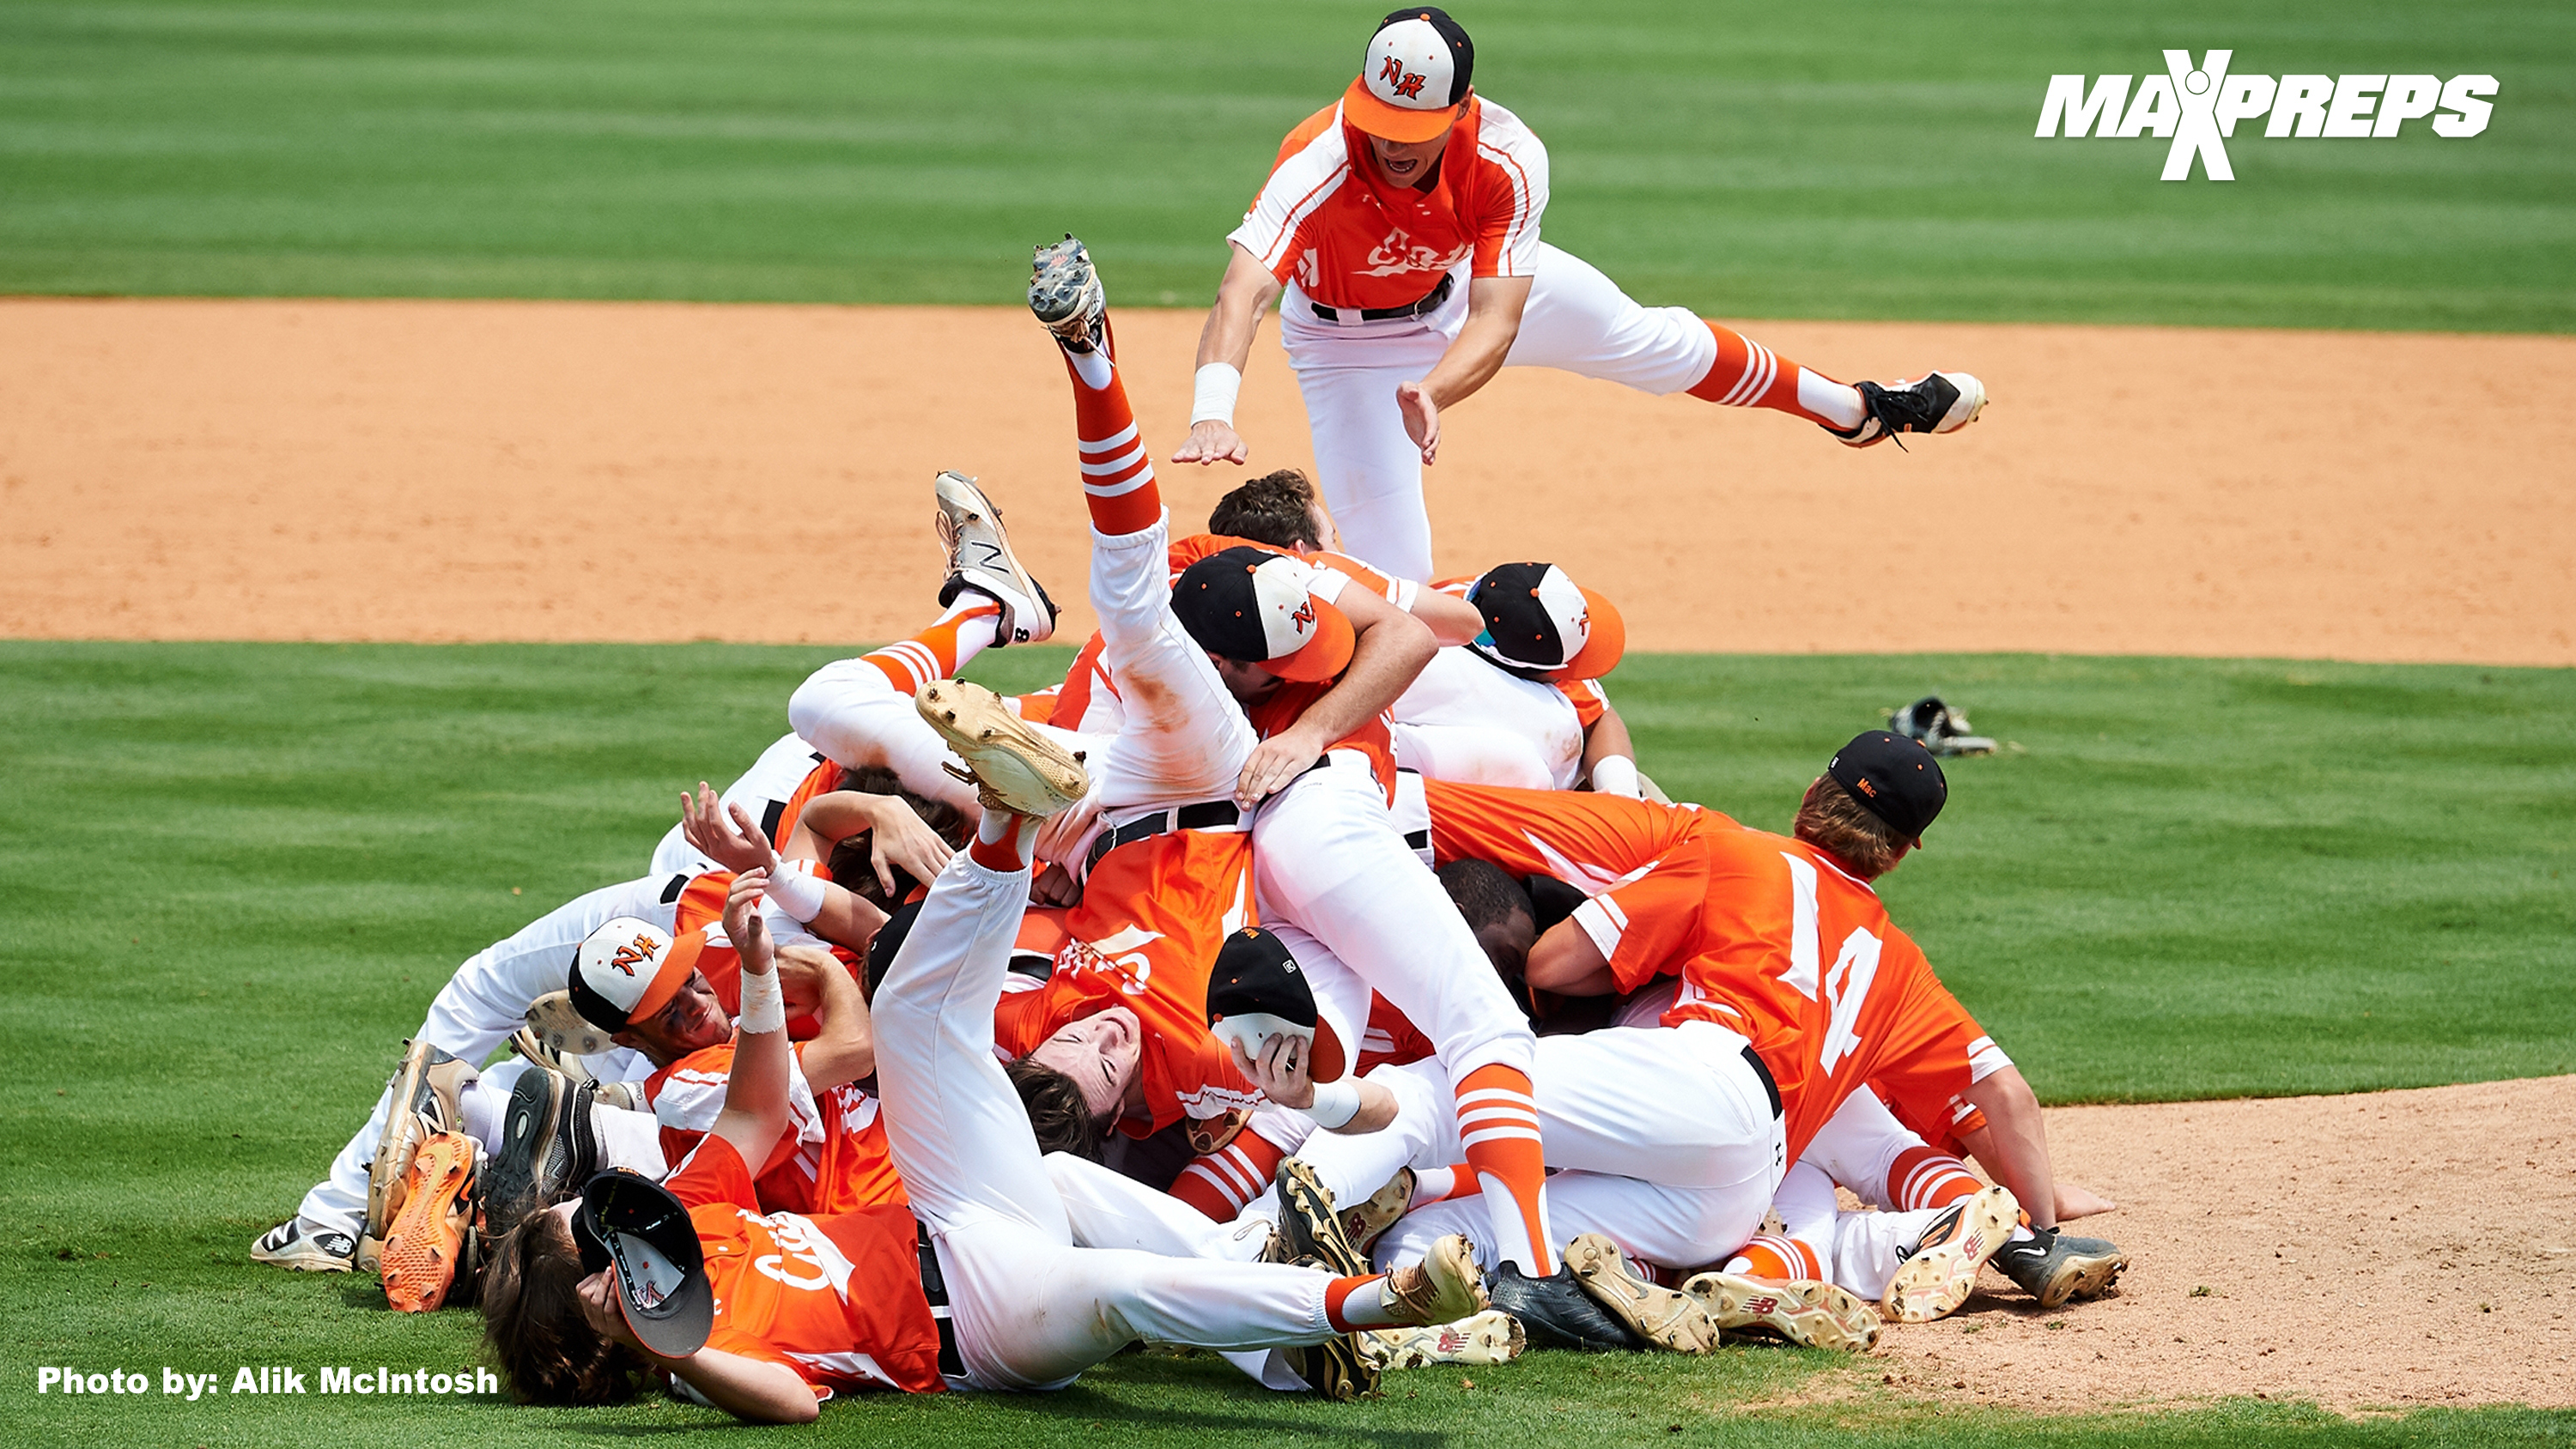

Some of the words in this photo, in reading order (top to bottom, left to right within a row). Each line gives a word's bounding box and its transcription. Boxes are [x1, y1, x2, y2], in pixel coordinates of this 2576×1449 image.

[1379, 55, 1426, 100] NH
[1856, 777, 1877, 798] Mac
[611, 933, 661, 977] NH
[1777, 851, 1883, 1078] 14
